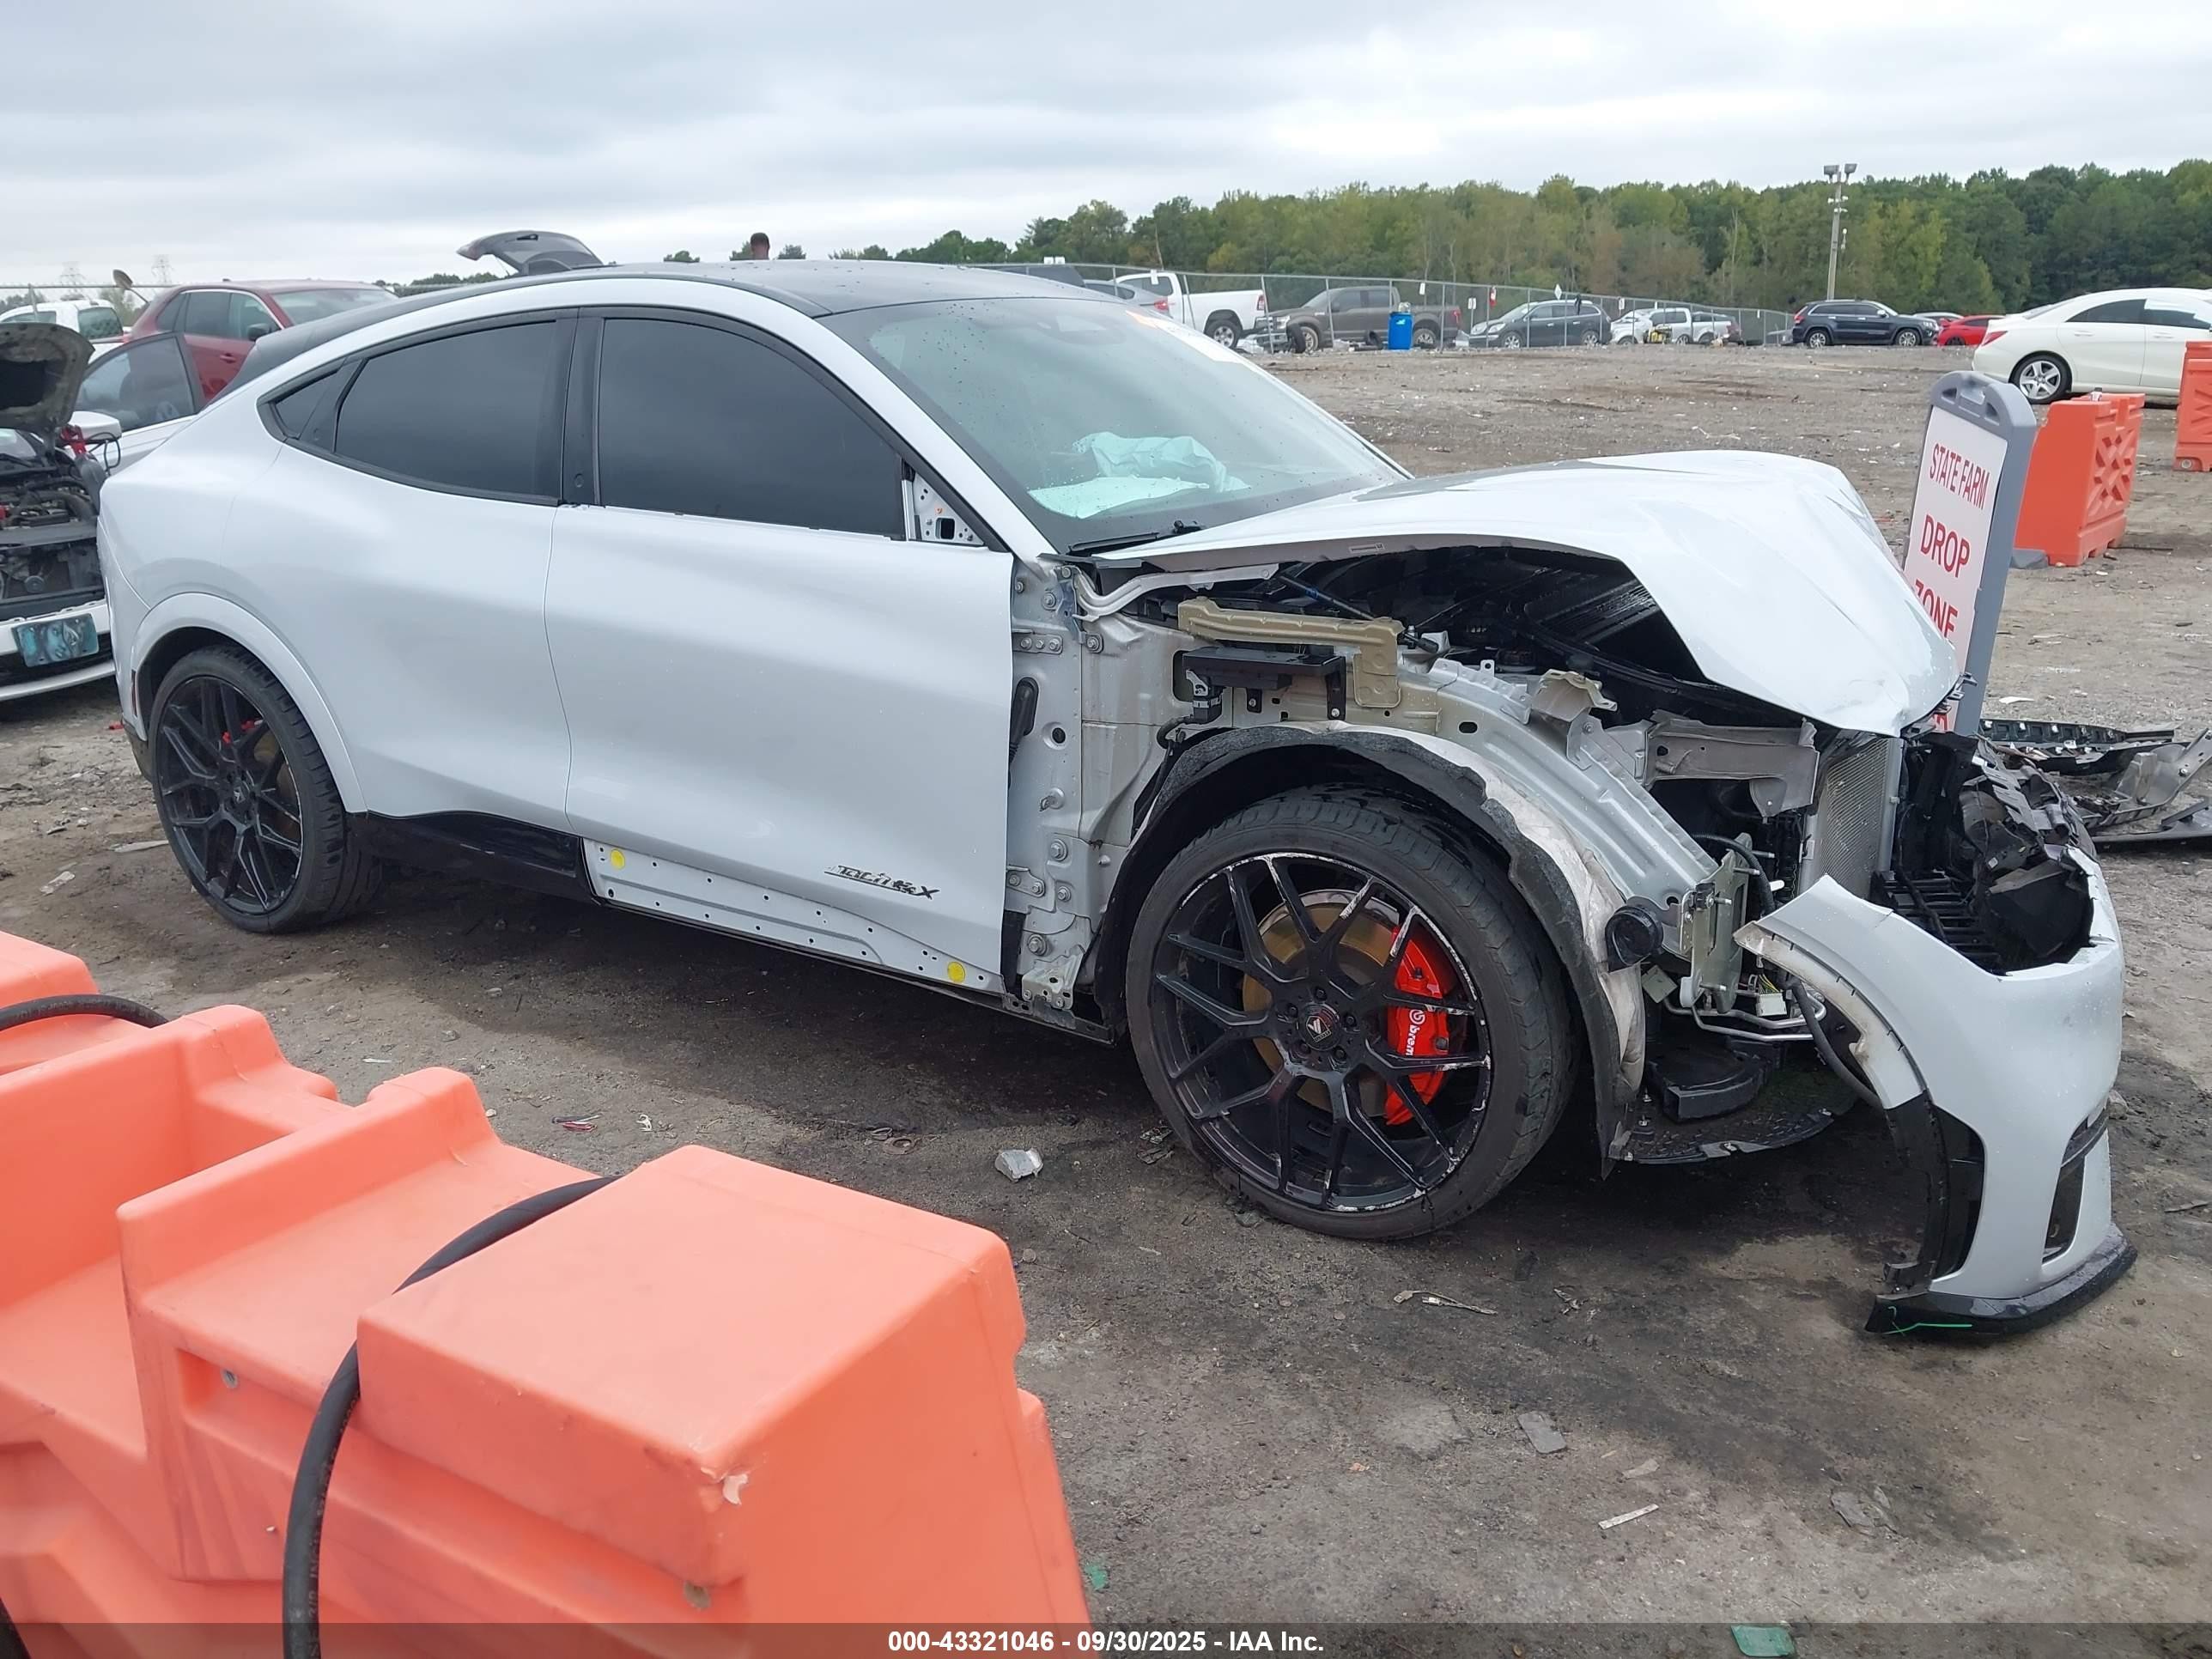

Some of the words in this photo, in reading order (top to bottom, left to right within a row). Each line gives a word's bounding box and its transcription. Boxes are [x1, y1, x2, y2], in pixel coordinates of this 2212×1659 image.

[1929, 442, 1962, 493] STATE
[1958, 459, 1990, 511] FARM
[1920, 514, 1971, 578] DROP
